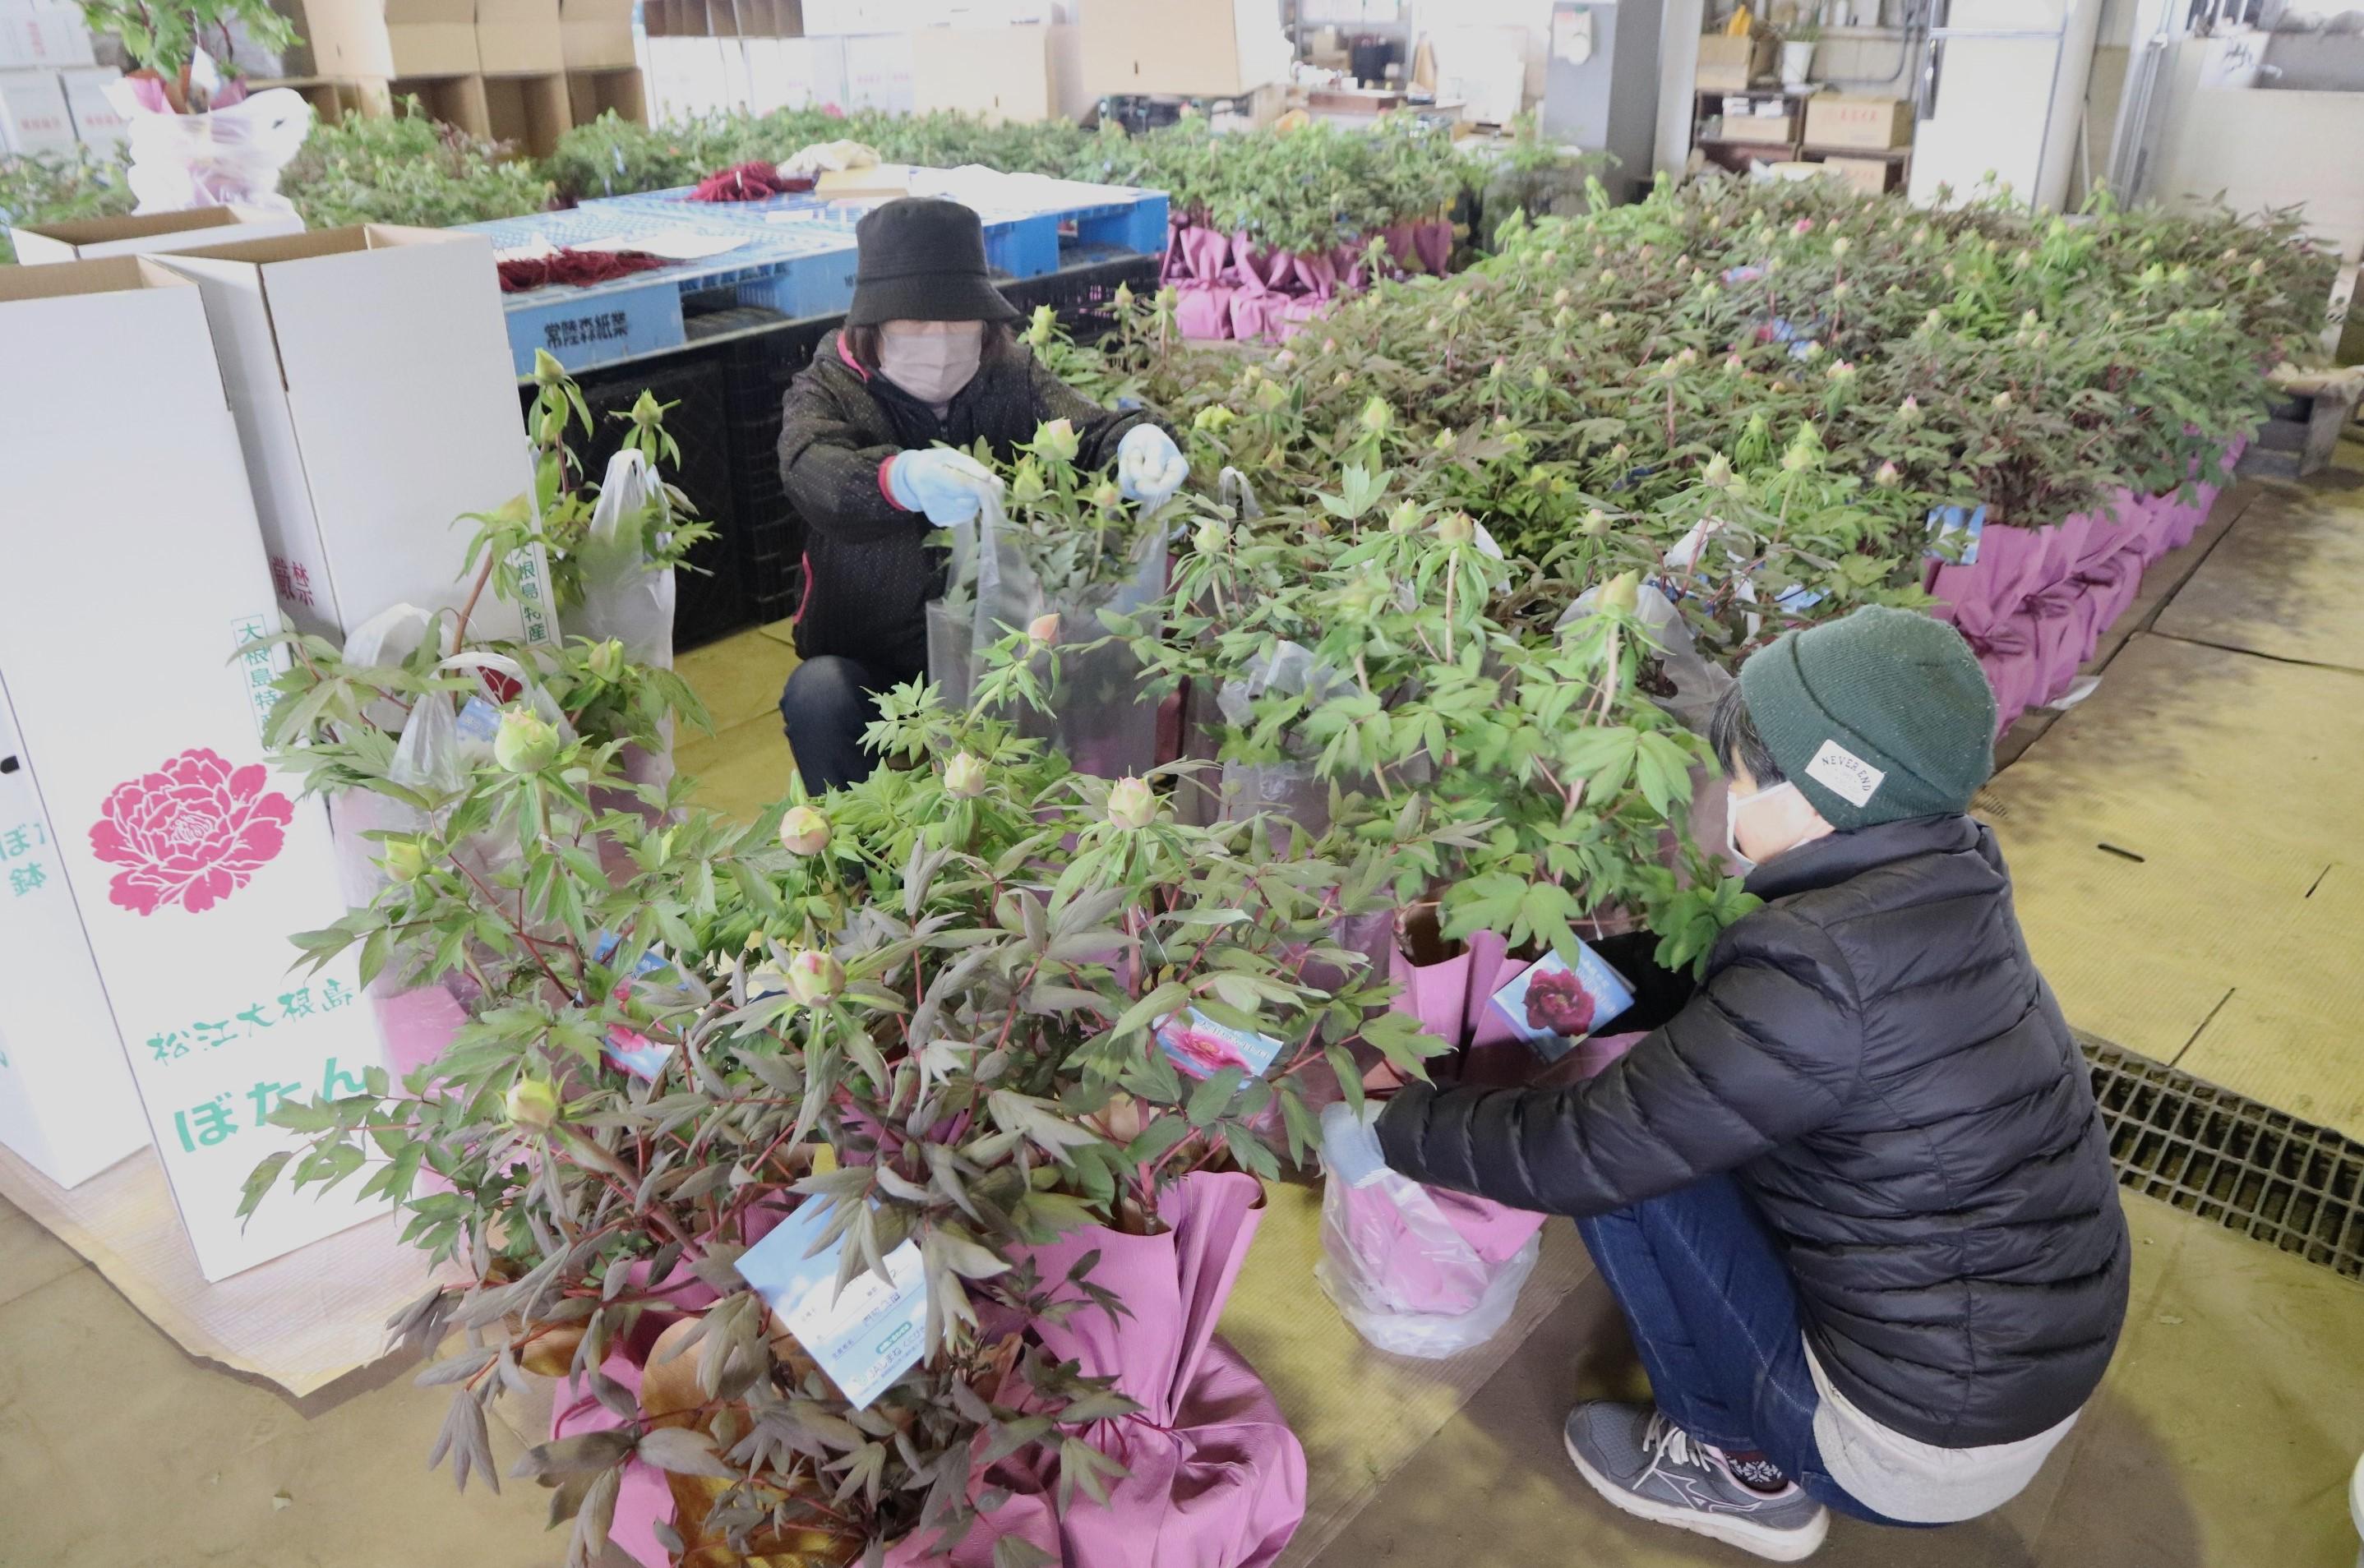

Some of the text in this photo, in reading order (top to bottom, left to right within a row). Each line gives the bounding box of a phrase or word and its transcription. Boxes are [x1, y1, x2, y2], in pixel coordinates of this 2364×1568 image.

[1821, 755, 1859, 772] NEVER
[1857, 769, 1872, 791] END
[146, 978, 353, 1067] 松江大根島
[173, 1057, 367, 1153] ぼたん
